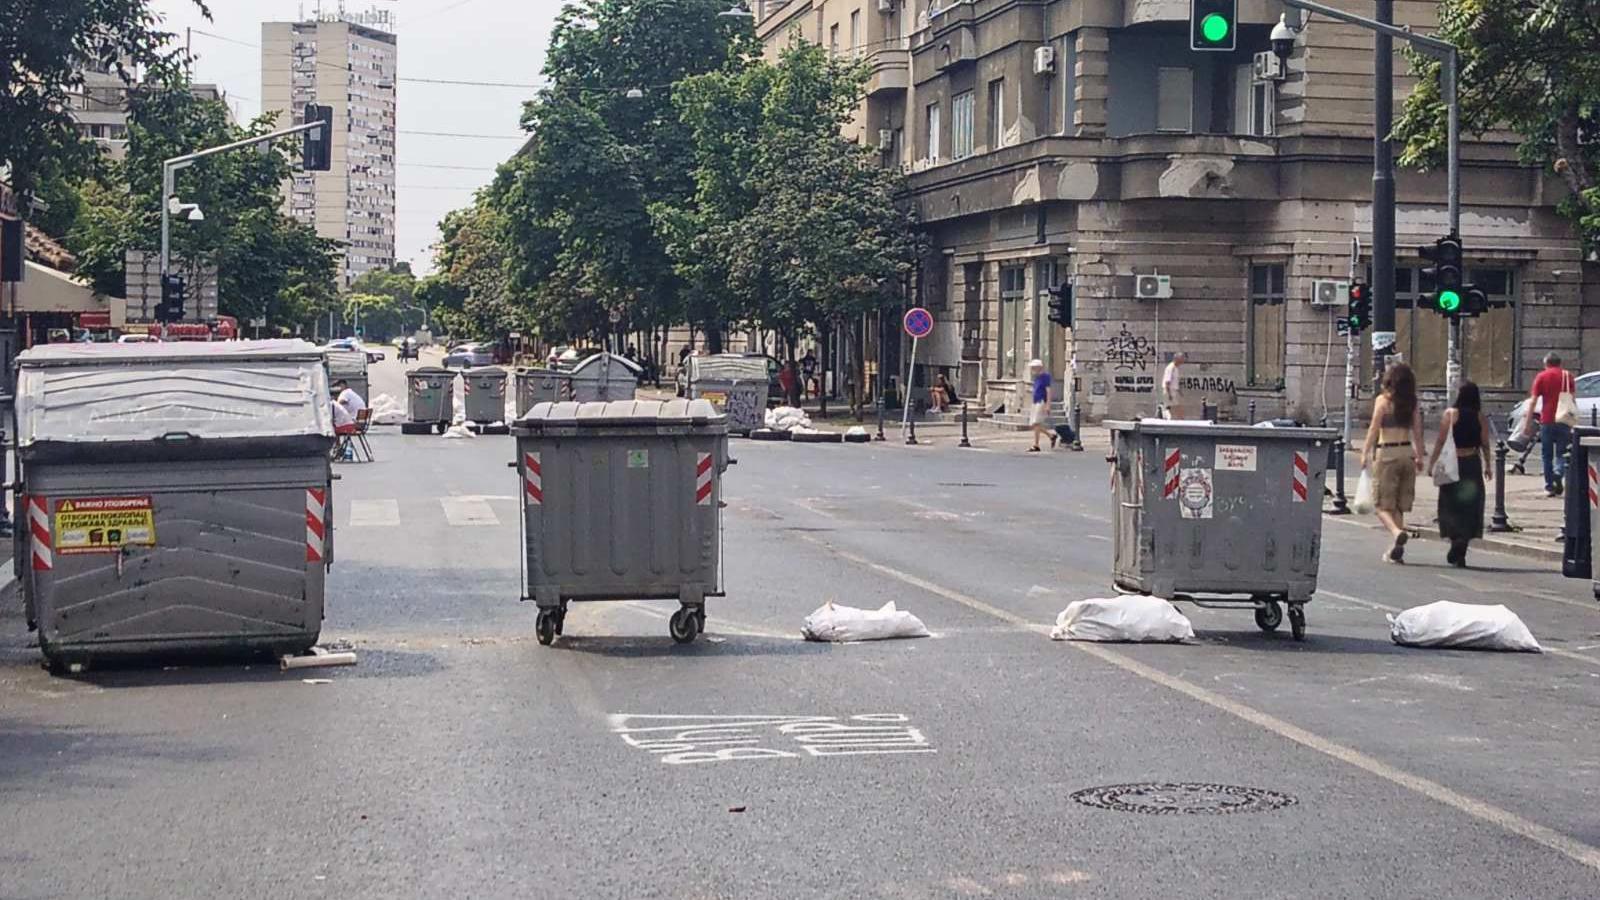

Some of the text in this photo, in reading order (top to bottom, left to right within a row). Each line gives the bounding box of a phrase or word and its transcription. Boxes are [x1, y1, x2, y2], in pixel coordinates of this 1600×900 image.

[75, 499, 148, 509] ВАЖНО УПОЗОРЕЊЕ
[60, 511, 147, 521] ОТВОРЕН ПОКЛОПАЦ
[61, 520, 105, 529] УГРОЖАВА
